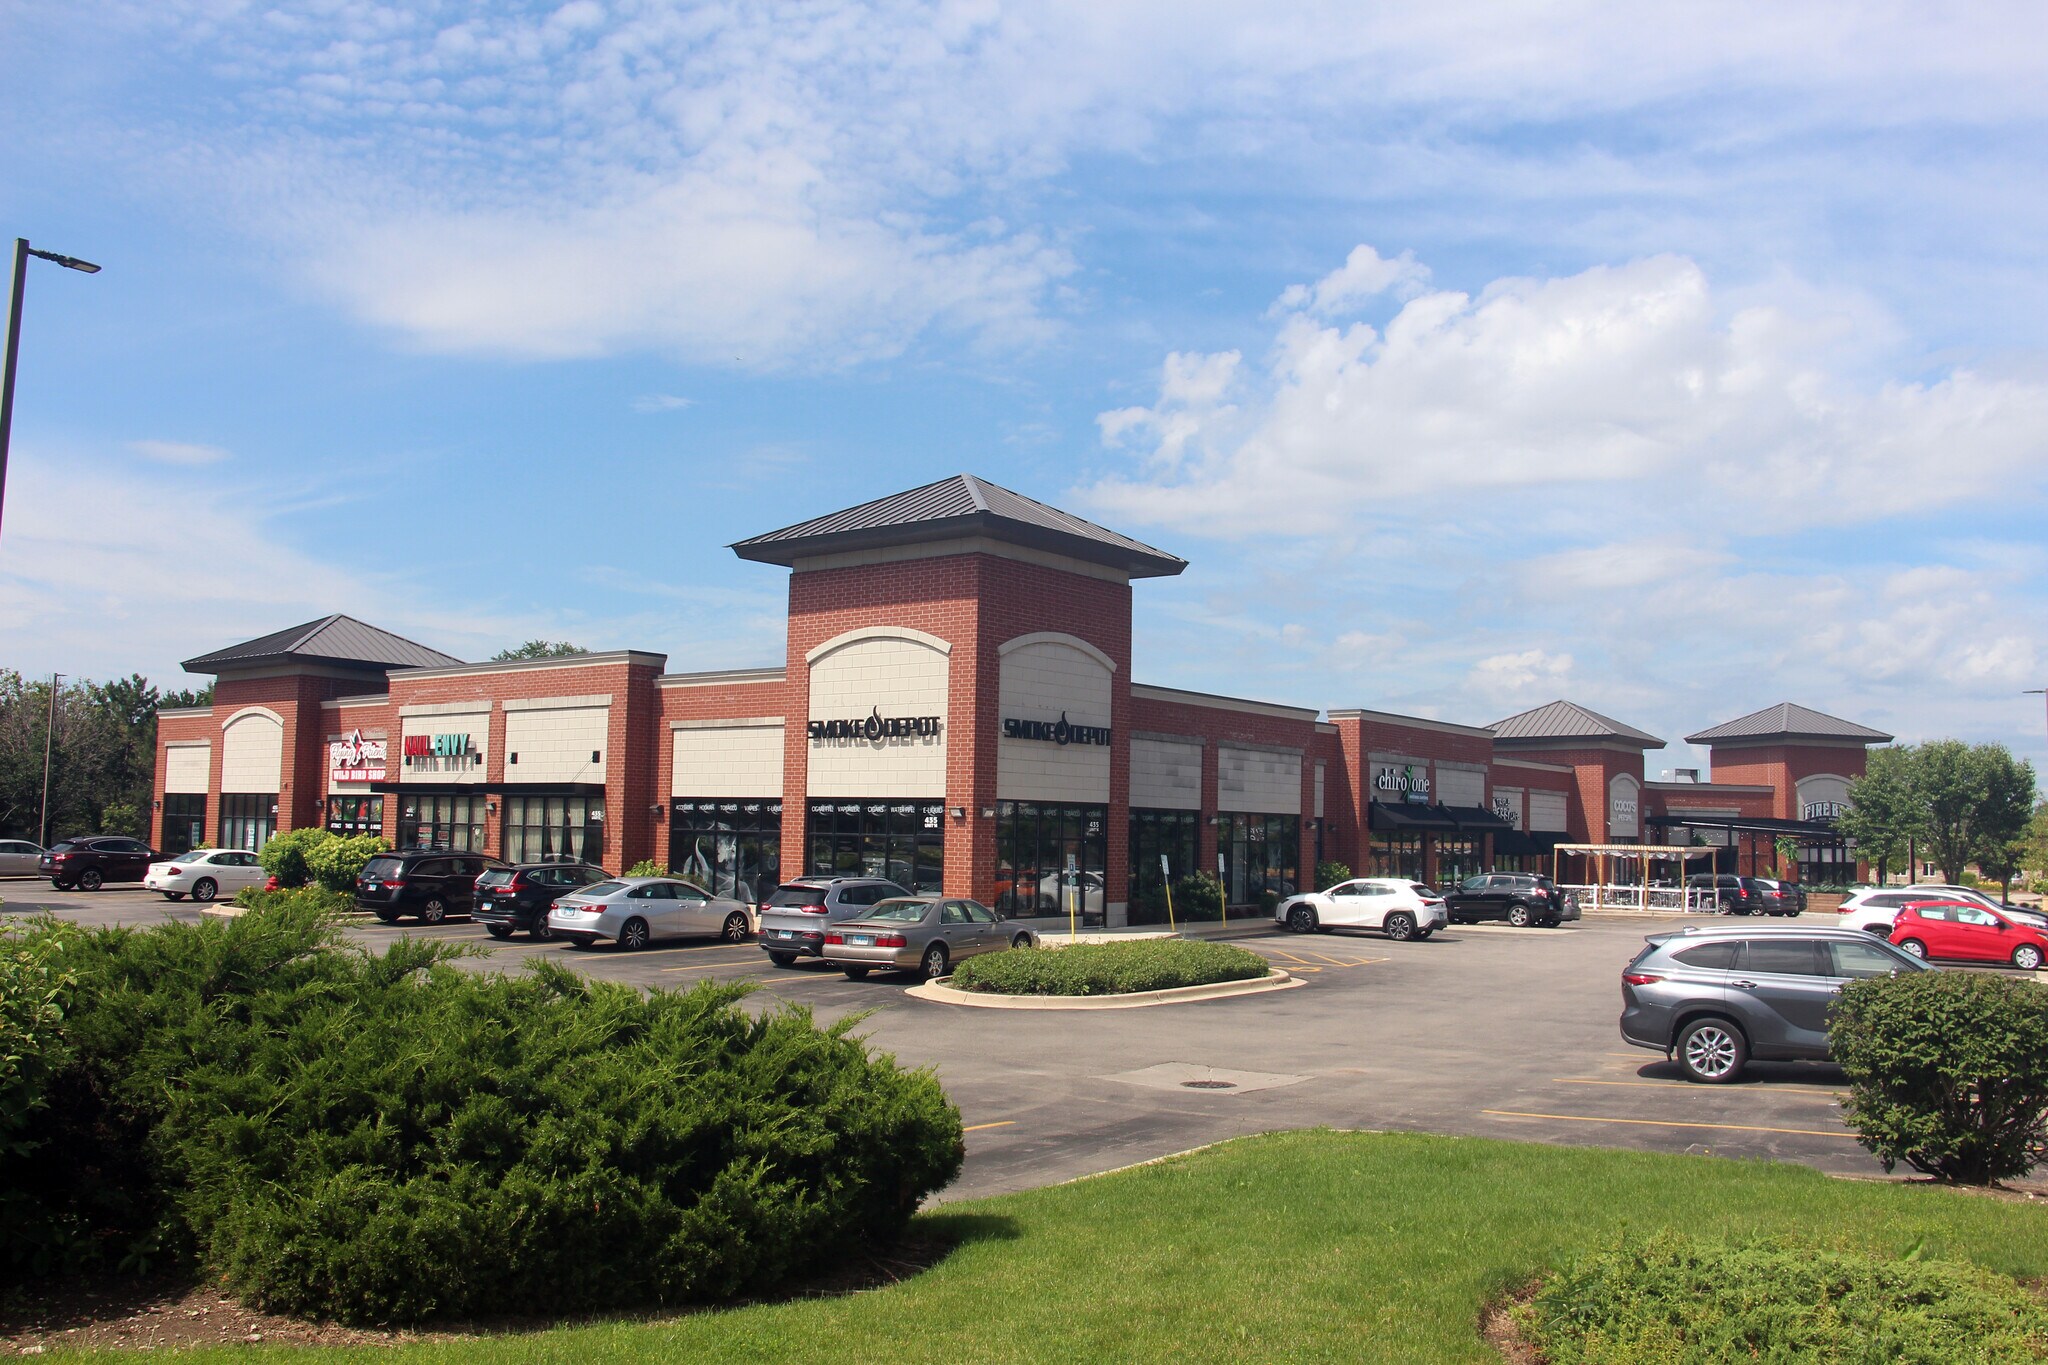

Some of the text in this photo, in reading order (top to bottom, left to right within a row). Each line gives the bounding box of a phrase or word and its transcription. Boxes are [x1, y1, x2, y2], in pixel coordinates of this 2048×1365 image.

[806, 717, 940, 739] SMOKE DEPOT
[1003, 719, 1055, 741] SMOKE
[330, 743, 355, 766] Flying
[405, 734, 469, 757] NAIL ENVY
[333, 769, 386, 780] WILD BIRD SHOP
[1379, 768, 1430, 793] chiro one
[924, 816, 938, 825] 435
[1805, 803, 1829, 820] FIRE
